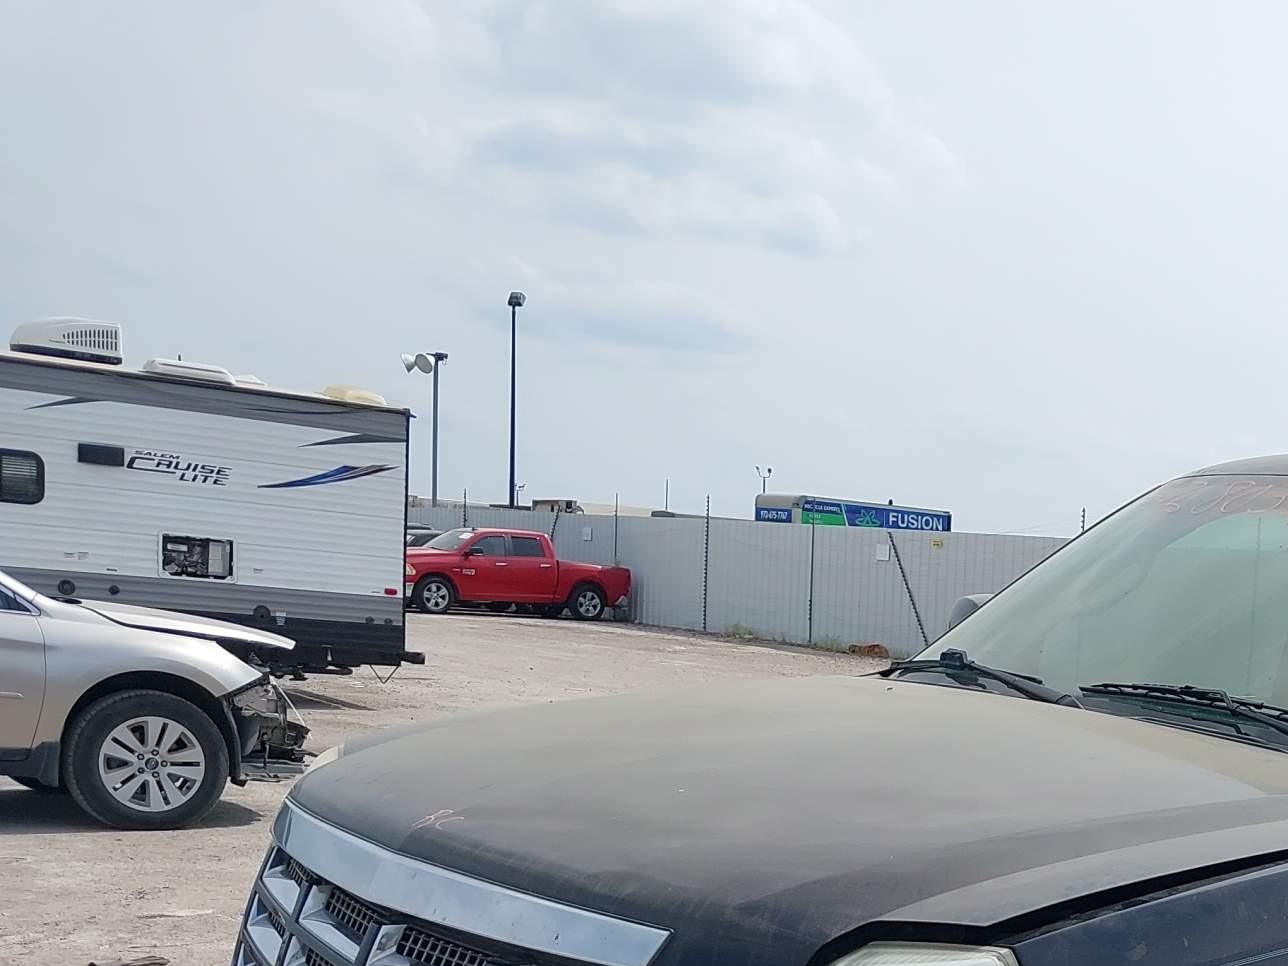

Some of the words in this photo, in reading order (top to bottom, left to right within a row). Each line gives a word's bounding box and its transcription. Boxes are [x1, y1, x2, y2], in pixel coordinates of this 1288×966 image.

[135, 450, 181, 460] SALEM
[126, 456, 233, 476] CRUISE
[179, 473, 228, 486] LITE
[888, 512, 944, 531] FUSION
